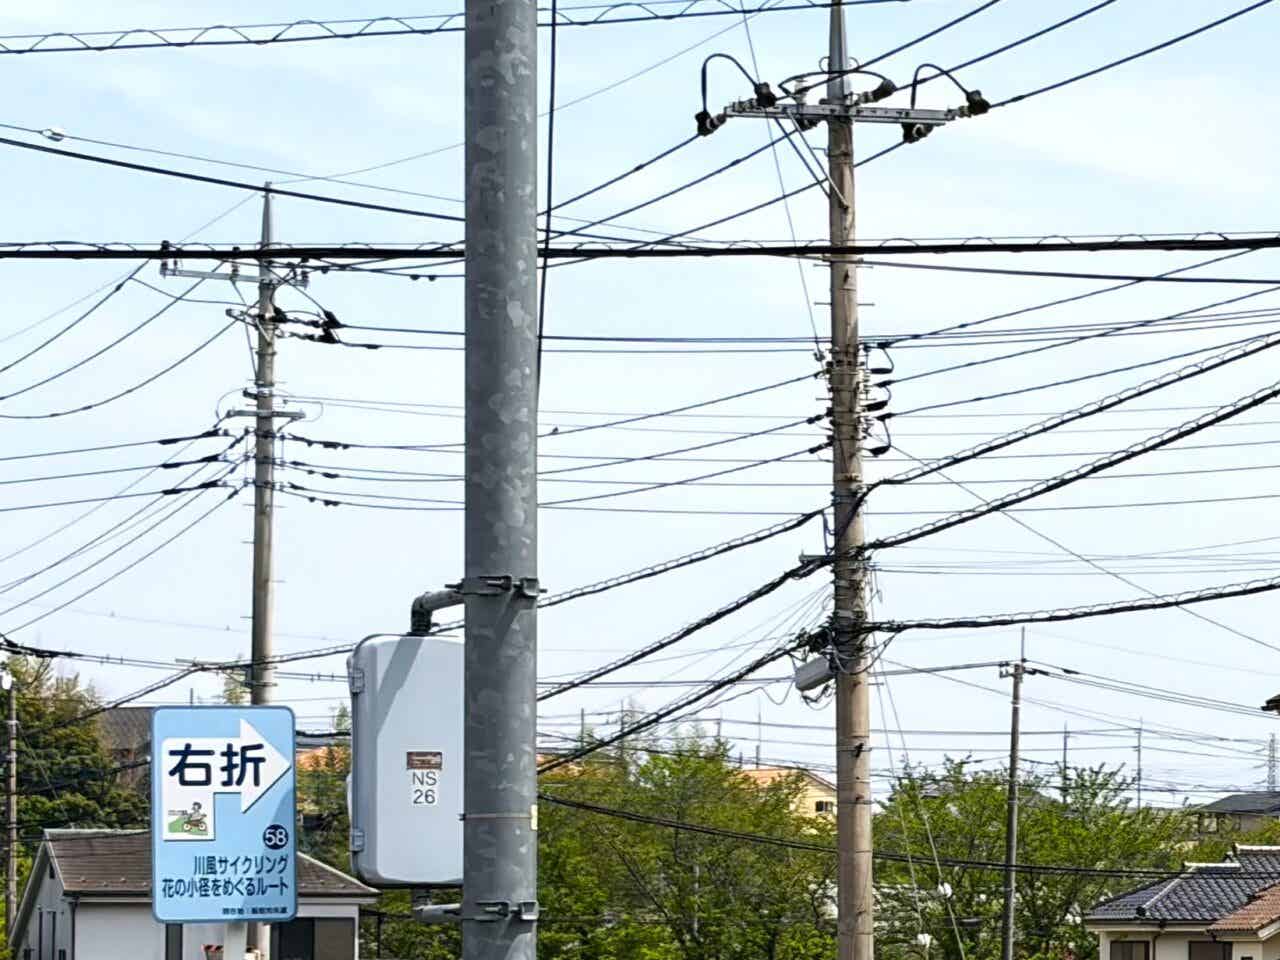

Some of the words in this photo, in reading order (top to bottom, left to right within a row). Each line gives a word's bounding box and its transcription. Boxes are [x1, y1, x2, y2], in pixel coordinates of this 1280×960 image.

[168, 742, 267, 787] 右折
[412, 771, 437, 786] NS
[413, 788, 436, 804] 26
[264, 829, 288, 845] 58
[194, 855, 289, 876] 川風サイクリング
[162, 876, 289, 898] 花の小径をめぐるルート
